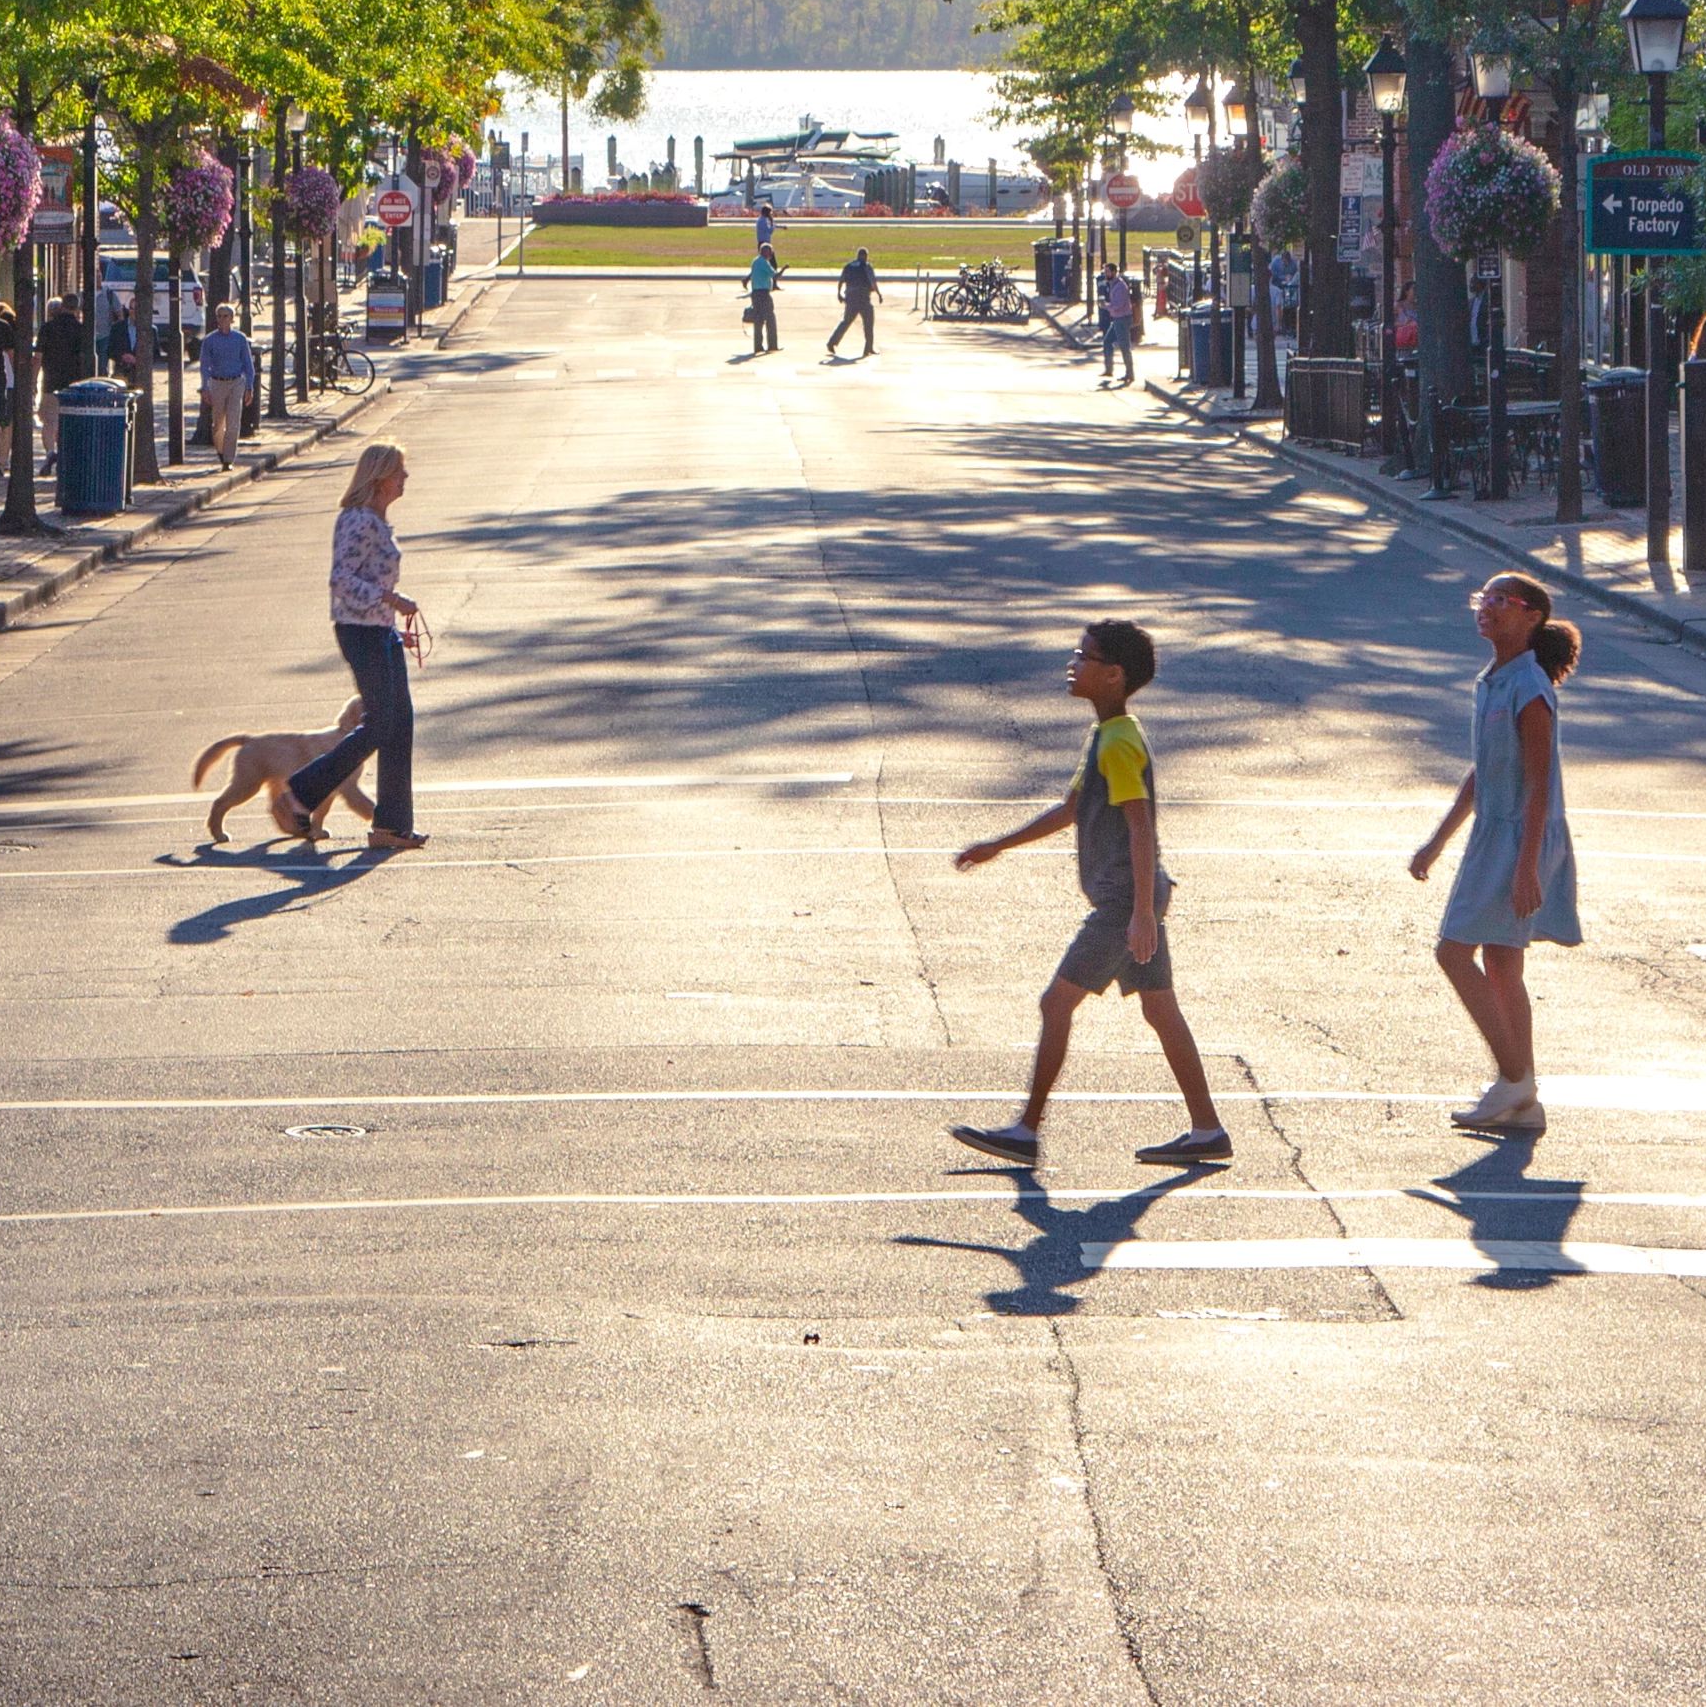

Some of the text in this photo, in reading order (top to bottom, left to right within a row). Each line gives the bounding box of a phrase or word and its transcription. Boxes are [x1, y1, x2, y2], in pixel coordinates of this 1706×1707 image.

[1622, 164, 1650, 176] OLD
[1628, 196, 1684, 215] Torpedo
[1628, 216, 1680, 236] Factory
